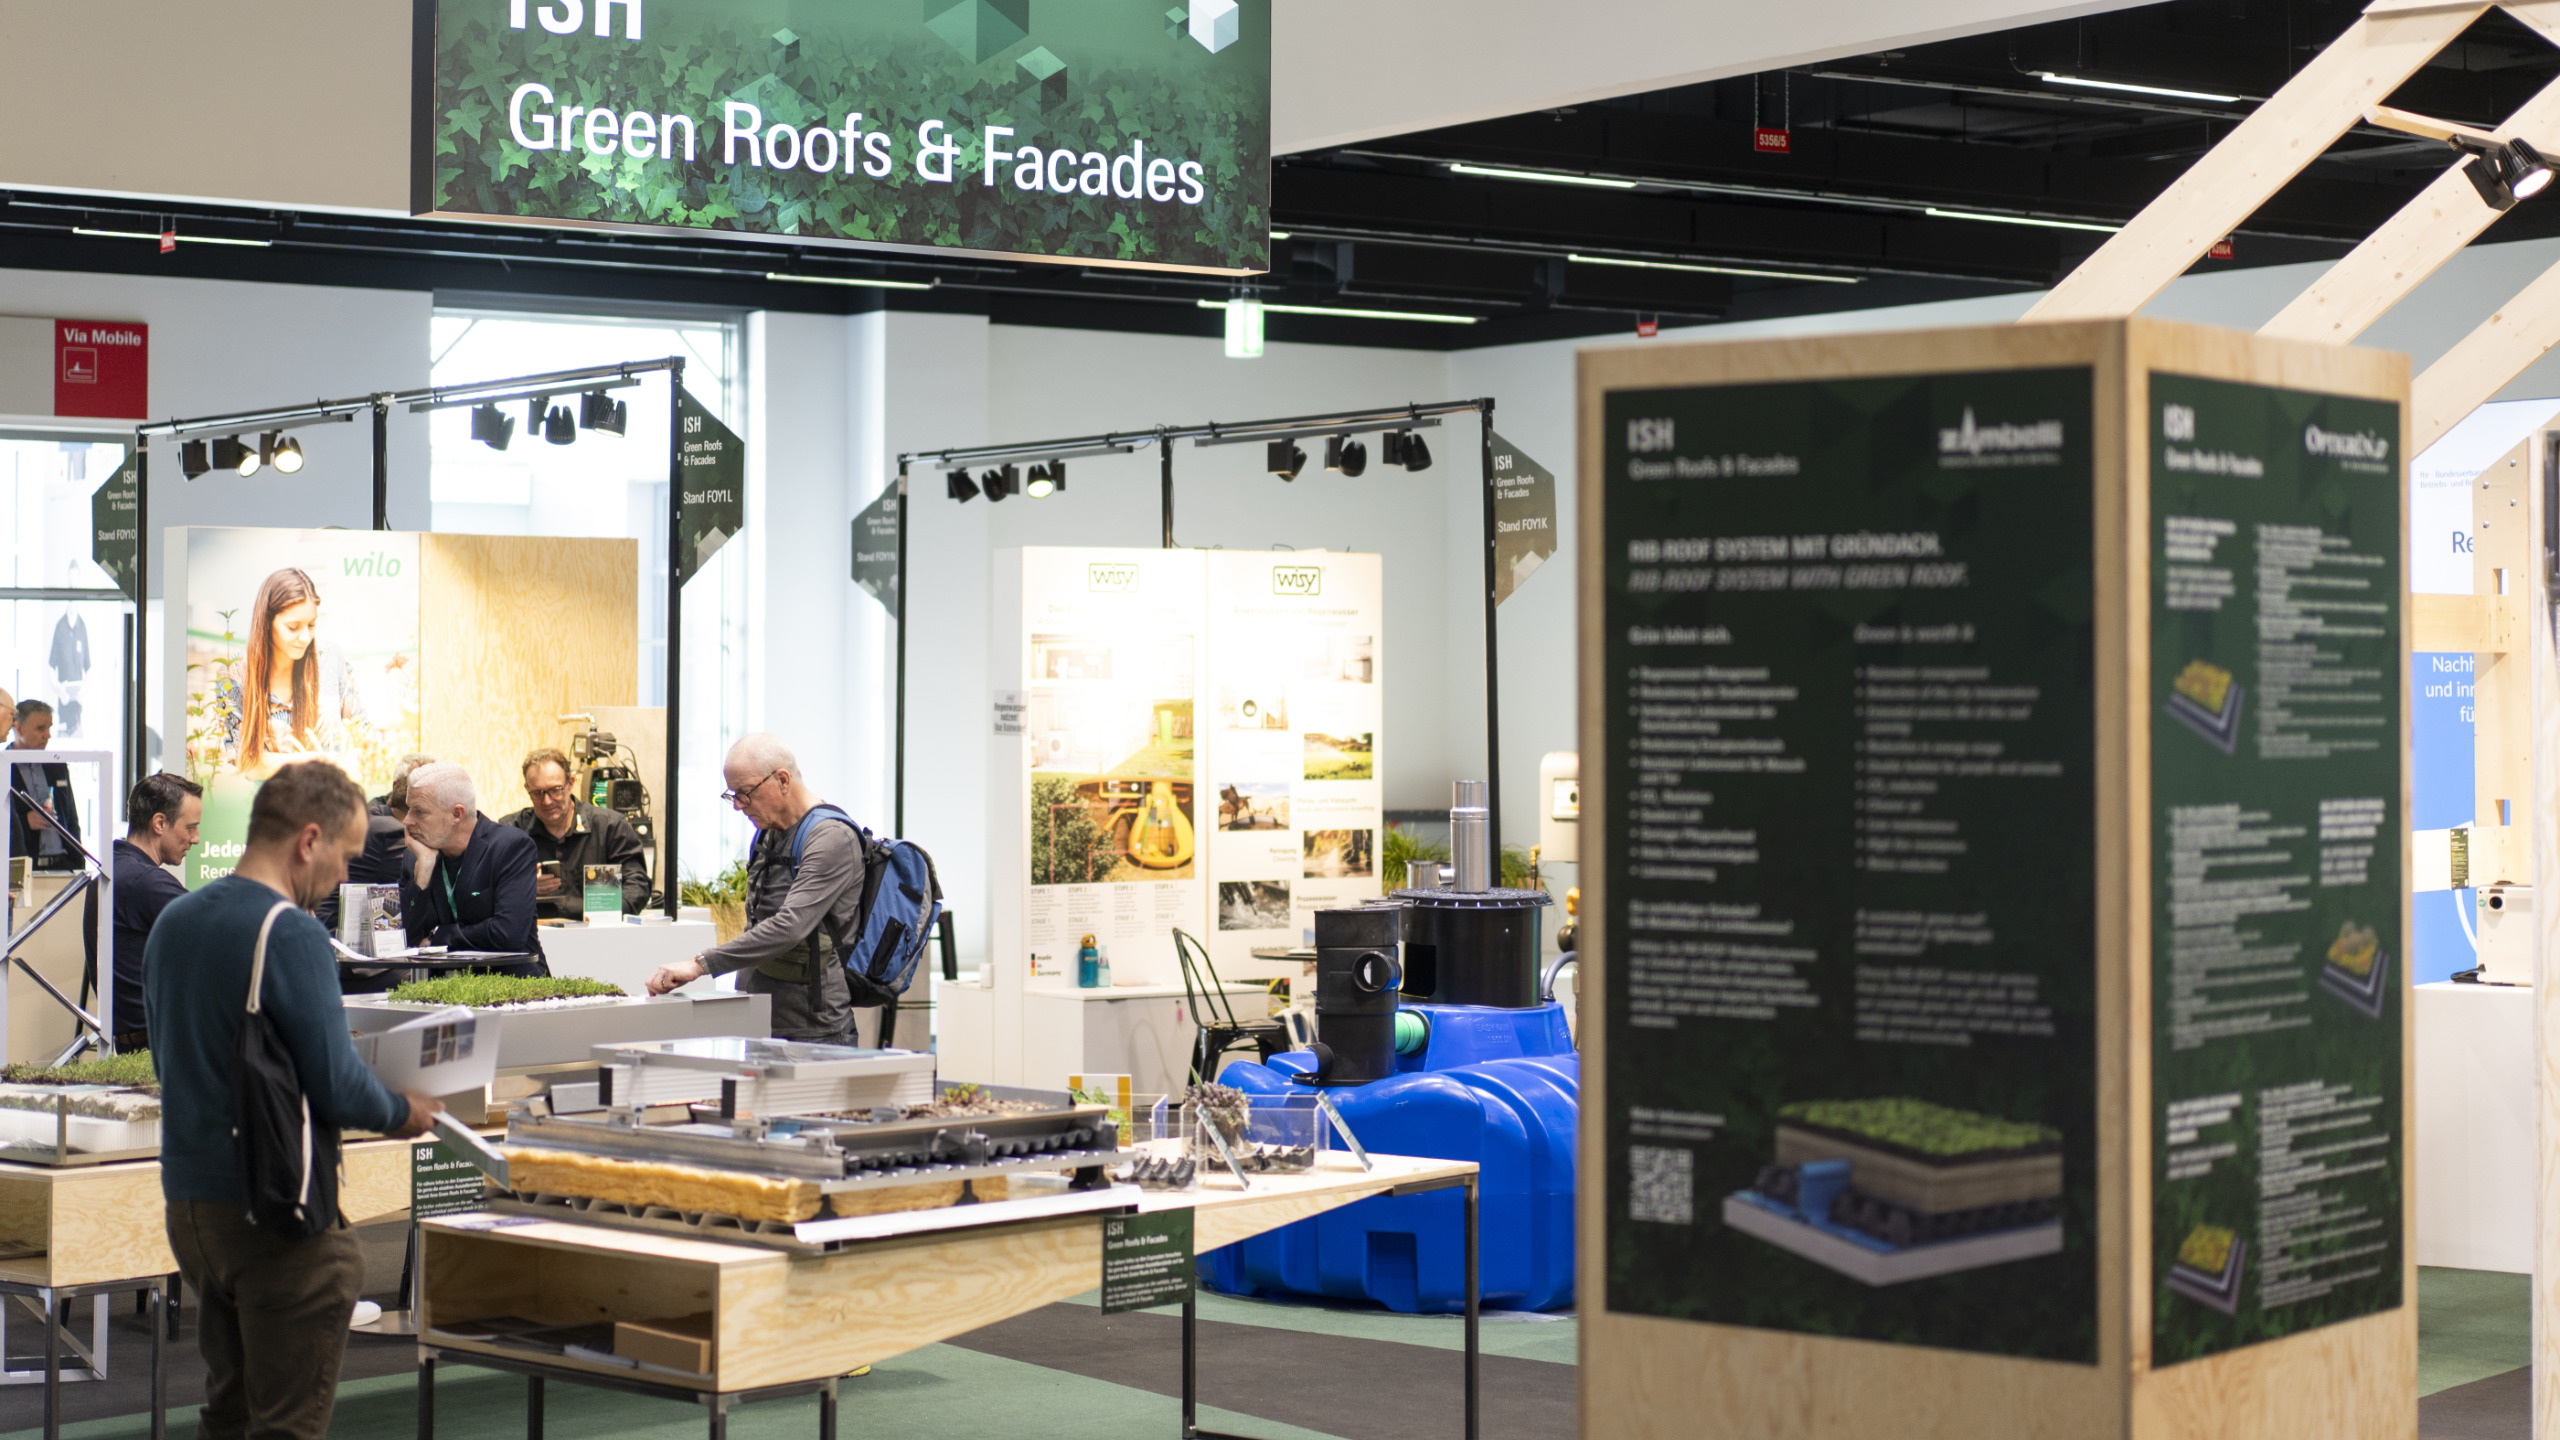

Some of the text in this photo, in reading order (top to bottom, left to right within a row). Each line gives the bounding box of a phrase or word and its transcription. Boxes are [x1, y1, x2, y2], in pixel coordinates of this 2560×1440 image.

[510, 82, 1204, 205] Green Roofs & Facades
[1759, 133, 1787, 147] 5356/5
[64, 328, 142, 347] Via Mobile
[684, 416, 701, 433] ISH
[1627, 418, 1674, 451] ISH
[684, 440, 722, 452] Green Roofs
[684, 454, 716, 466] & Facades
[1495, 454, 1513, 471] ISH
[1629, 458, 1674, 480] Green
[1675, 456, 1719, 478] Roofs
[1736, 453, 1799, 476] Facades
[123, 470, 136, 484] ISH
[1497, 475, 1535, 487] Green Roofs
[683, 490, 705, 504] Stand
[1497, 488, 1530, 499] & Facades
[883, 499, 896, 511] ISH
[1498, 520, 1520, 533] Stand
[98, 530, 115, 541] Stand
[1714, 537, 1789, 561] SYSTEM
[344, 551, 401, 577] wilo
[1277, 568, 1316, 593] wisy
[2426, 681, 2453, 697] und
[416, 1148, 433, 1161] ISH
[416, 1165, 433, 1173] Green
[434, 1163, 449, 1171] Roofs
[1107, 1221, 1124, 1236] ISH
